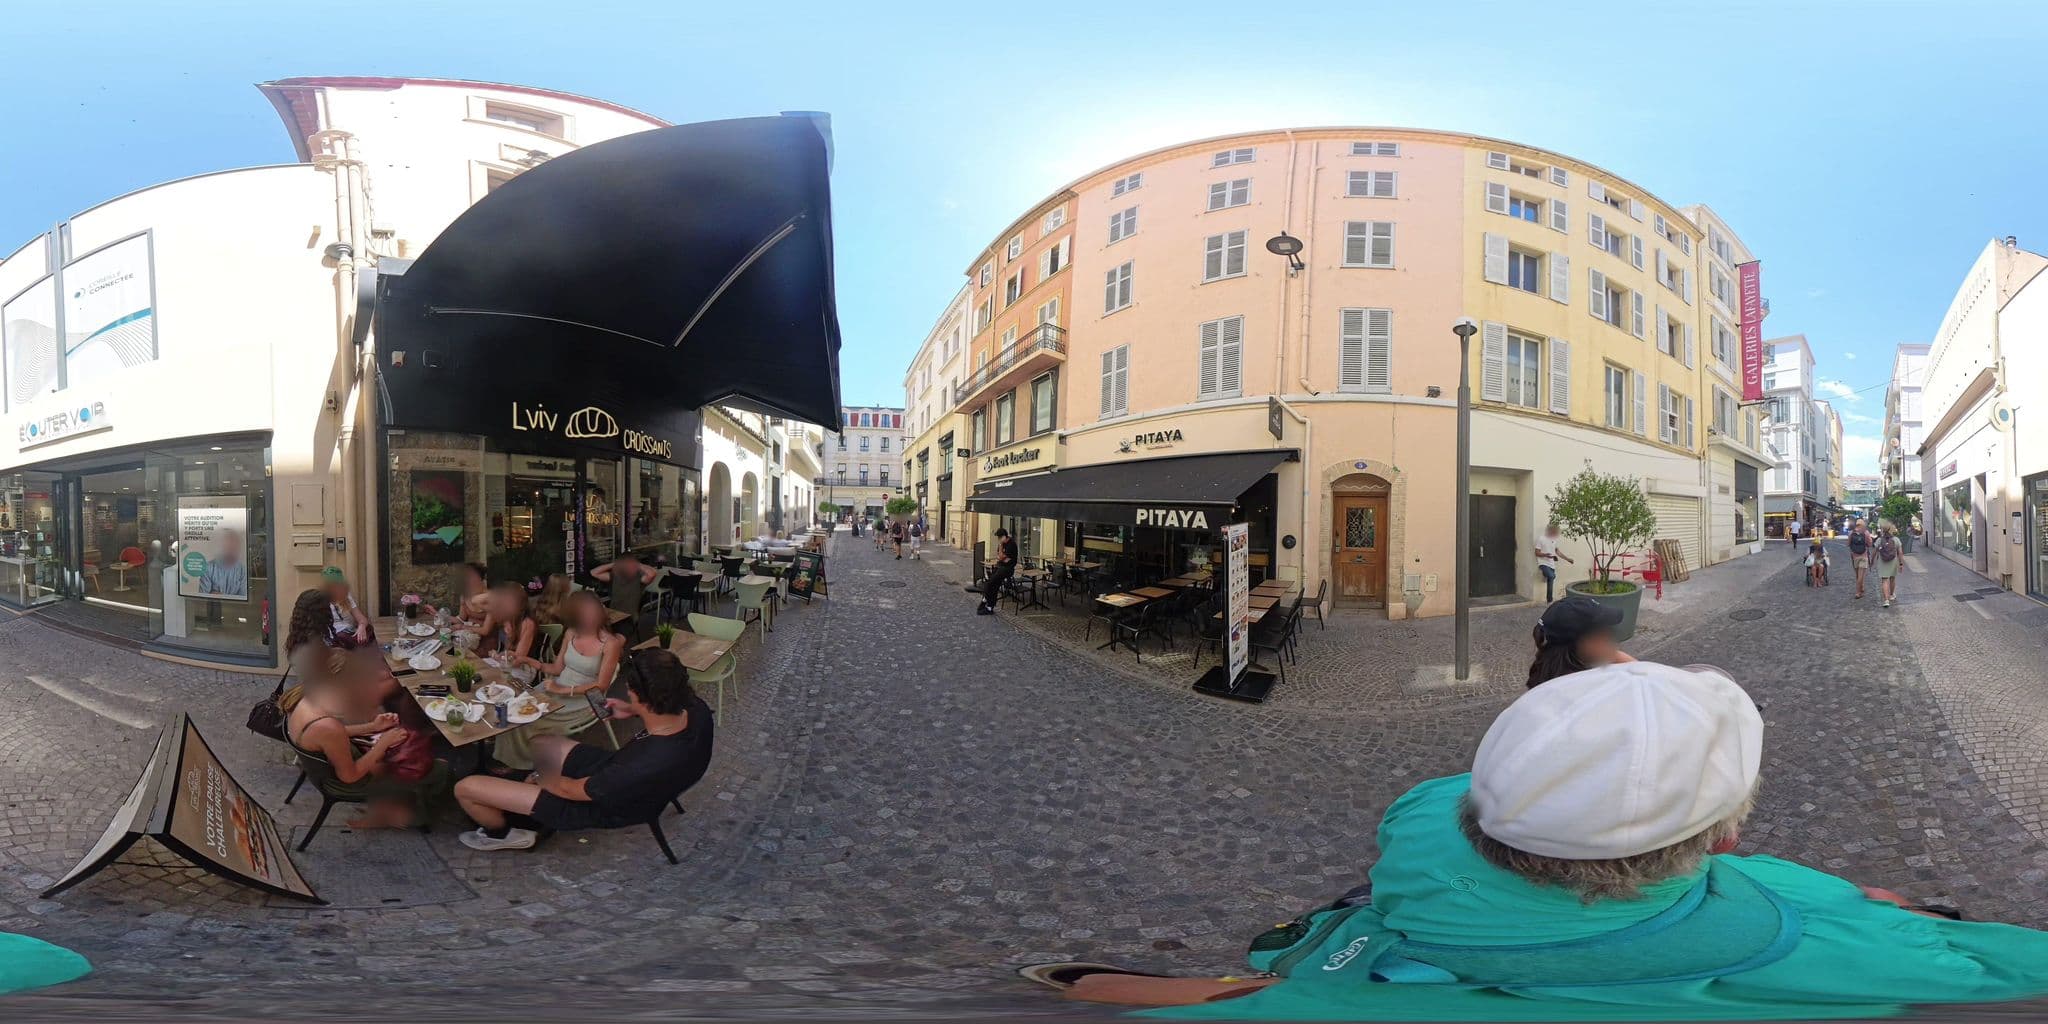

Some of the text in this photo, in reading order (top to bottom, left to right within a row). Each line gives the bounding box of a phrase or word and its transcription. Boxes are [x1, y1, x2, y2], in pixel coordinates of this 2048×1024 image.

[1744, 272, 1758, 385] GALERIES LAFAYETTE
[512, 401, 558, 431] Lviv
[623, 429, 672, 459] CROISSANTS
[1135, 429, 1183, 446] PITAYA
[1135, 508, 1209, 529] PITAYA
[206, 761, 216, 847] VOTRE PAUSE
[214, 766, 227, 858] CHALEUREUSE
